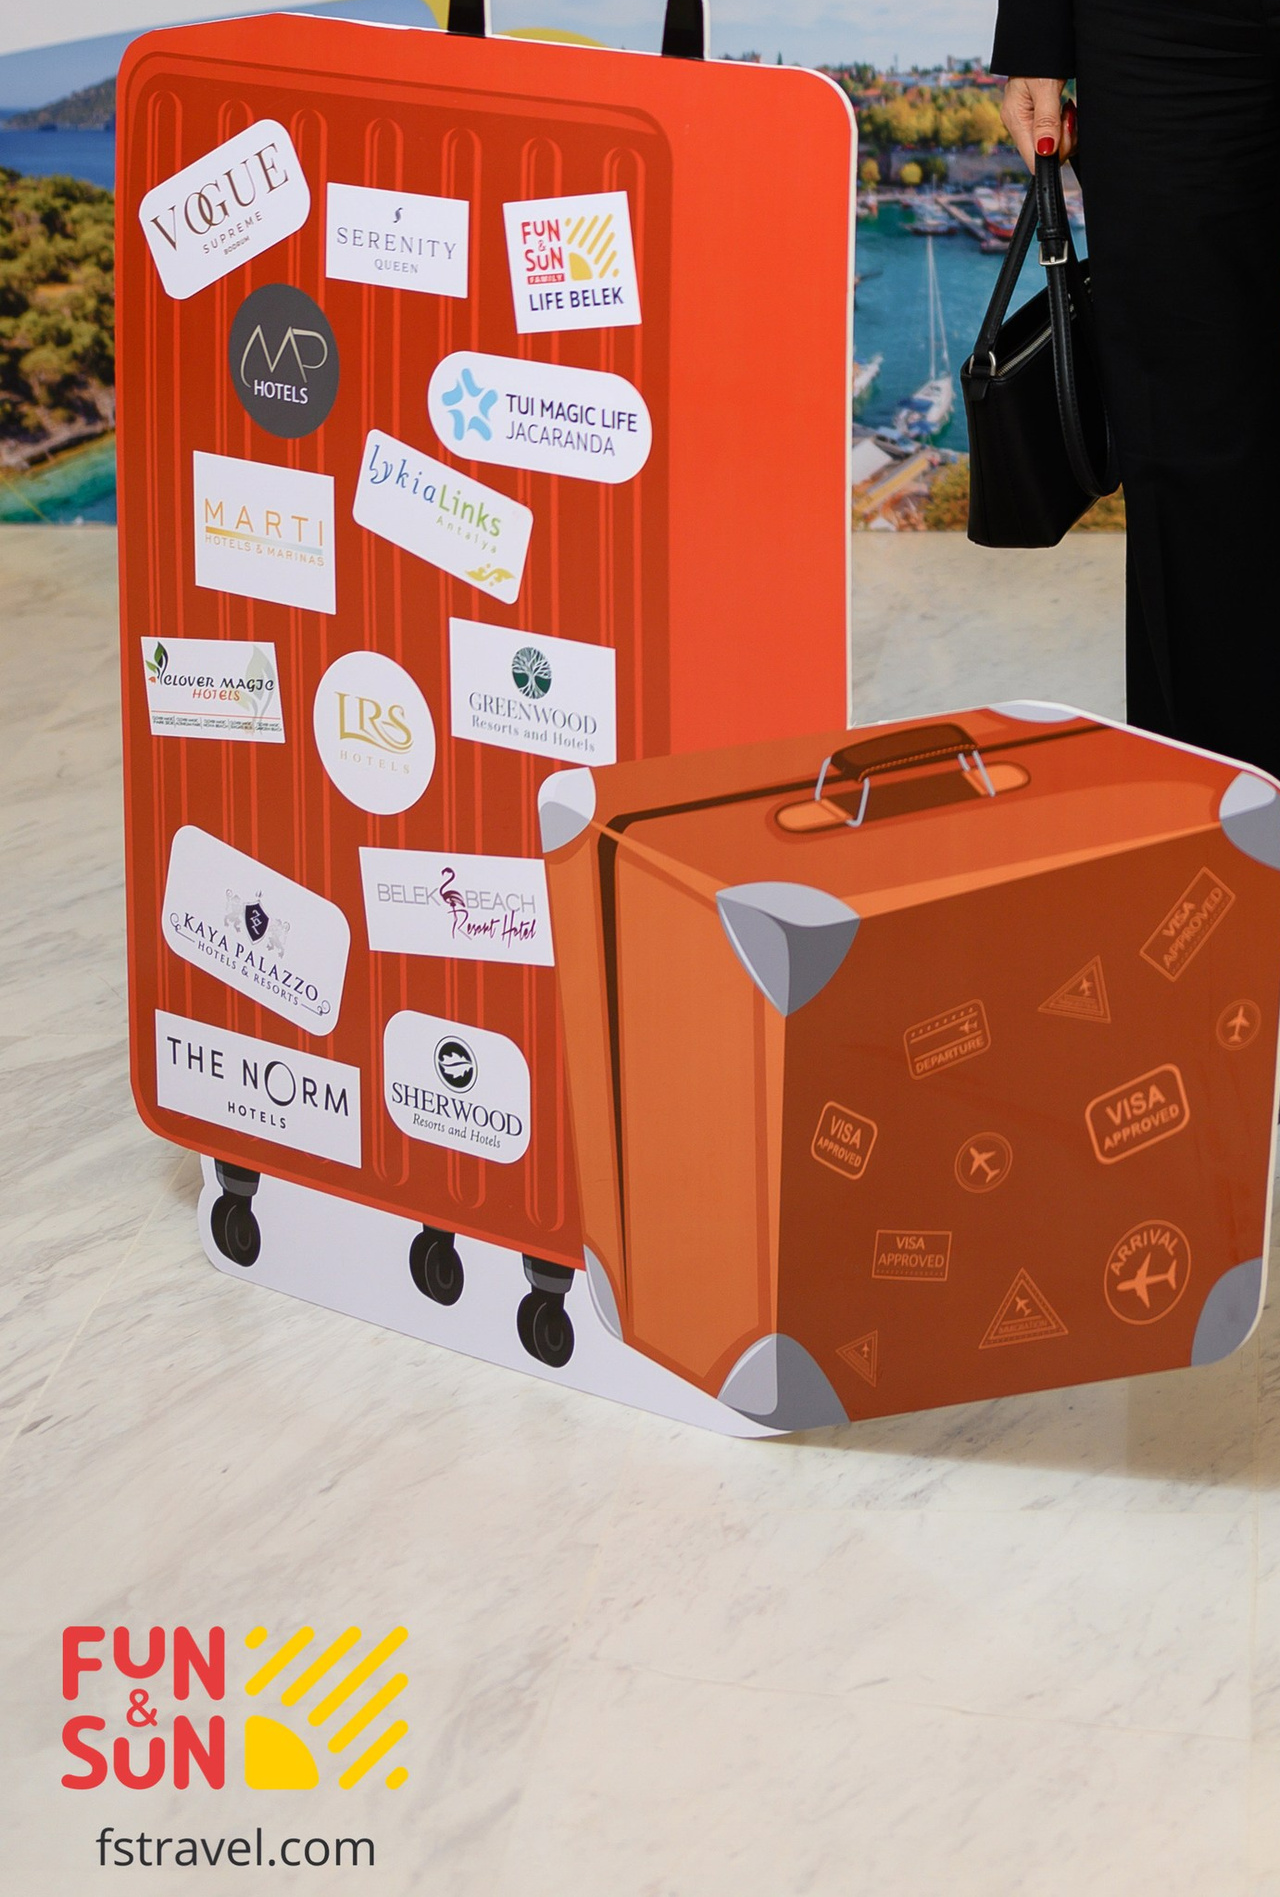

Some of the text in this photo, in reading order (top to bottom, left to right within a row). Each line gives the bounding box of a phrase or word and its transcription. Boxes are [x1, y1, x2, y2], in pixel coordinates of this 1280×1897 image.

[149, 142, 290, 252] VOGUE
[202, 210, 264, 255] SUPREME
[223, 235, 251, 255] BODRUM
[336, 226, 457, 260] SERENITY
[521, 219, 561, 245] FUN
[374, 258, 419, 274] QUEEN
[524, 246, 564, 272] SUN
[529, 286, 624, 312] LIFE BELEK
[253, 379, 309, 405] HOTELS
[505, 393, 638, 433] TUI MAGIC LIFE
[506, 420, 616, 457] JACARANDA
[204, 497, 323, 547] MARTI
[436, 515, 498, 554] Antalya
[205, 534, 252, 552] HOTELS
[267, 546, 325, 567] MARINAS
[163, 674, 275, 693] CLOVER MAGIC
[192, 688, 241, 702] HOTELS
[334, 690, 415, 755] LRS
[468, 691, 598, 736] GREENWOOD
[472, 714, 596, 753] Resorts and Hotels
[340, 749, 411, 775] HOTELS
[377, 883, 537, 914] BELEK BEACH
[1161, 900, 1197, 938] VISA
[1162, 886, 1224, 970] APPROVED
[183, 911, 319, 1002] KAYA PALAZZO
[197, 940, 300, 1007] HOTELS & RESORTS
[914, 1035, 986, 1075] DEPARTURE
[166, 1035, 350, 1117] THE NORM
[227, 1100, 288, 1130] HOTELS
[391, 1081, 524, 1138] SHERWOOD
[1104, 1083, 1167, 1128] VISA
[412, 1113, 502, 1149] Resorts and Hotels
[830, 1114, 863, 1150] VISA
[1102, 1102, 1181, 1152] APPROVED
[816, 1136, 863, 1169] APPROVED
[877, 1252, 946, 1269] APPROVED
[895, 1235, 926, 1251] VISA
[1109, 1227, 1180, 1277] ARRIVAL
